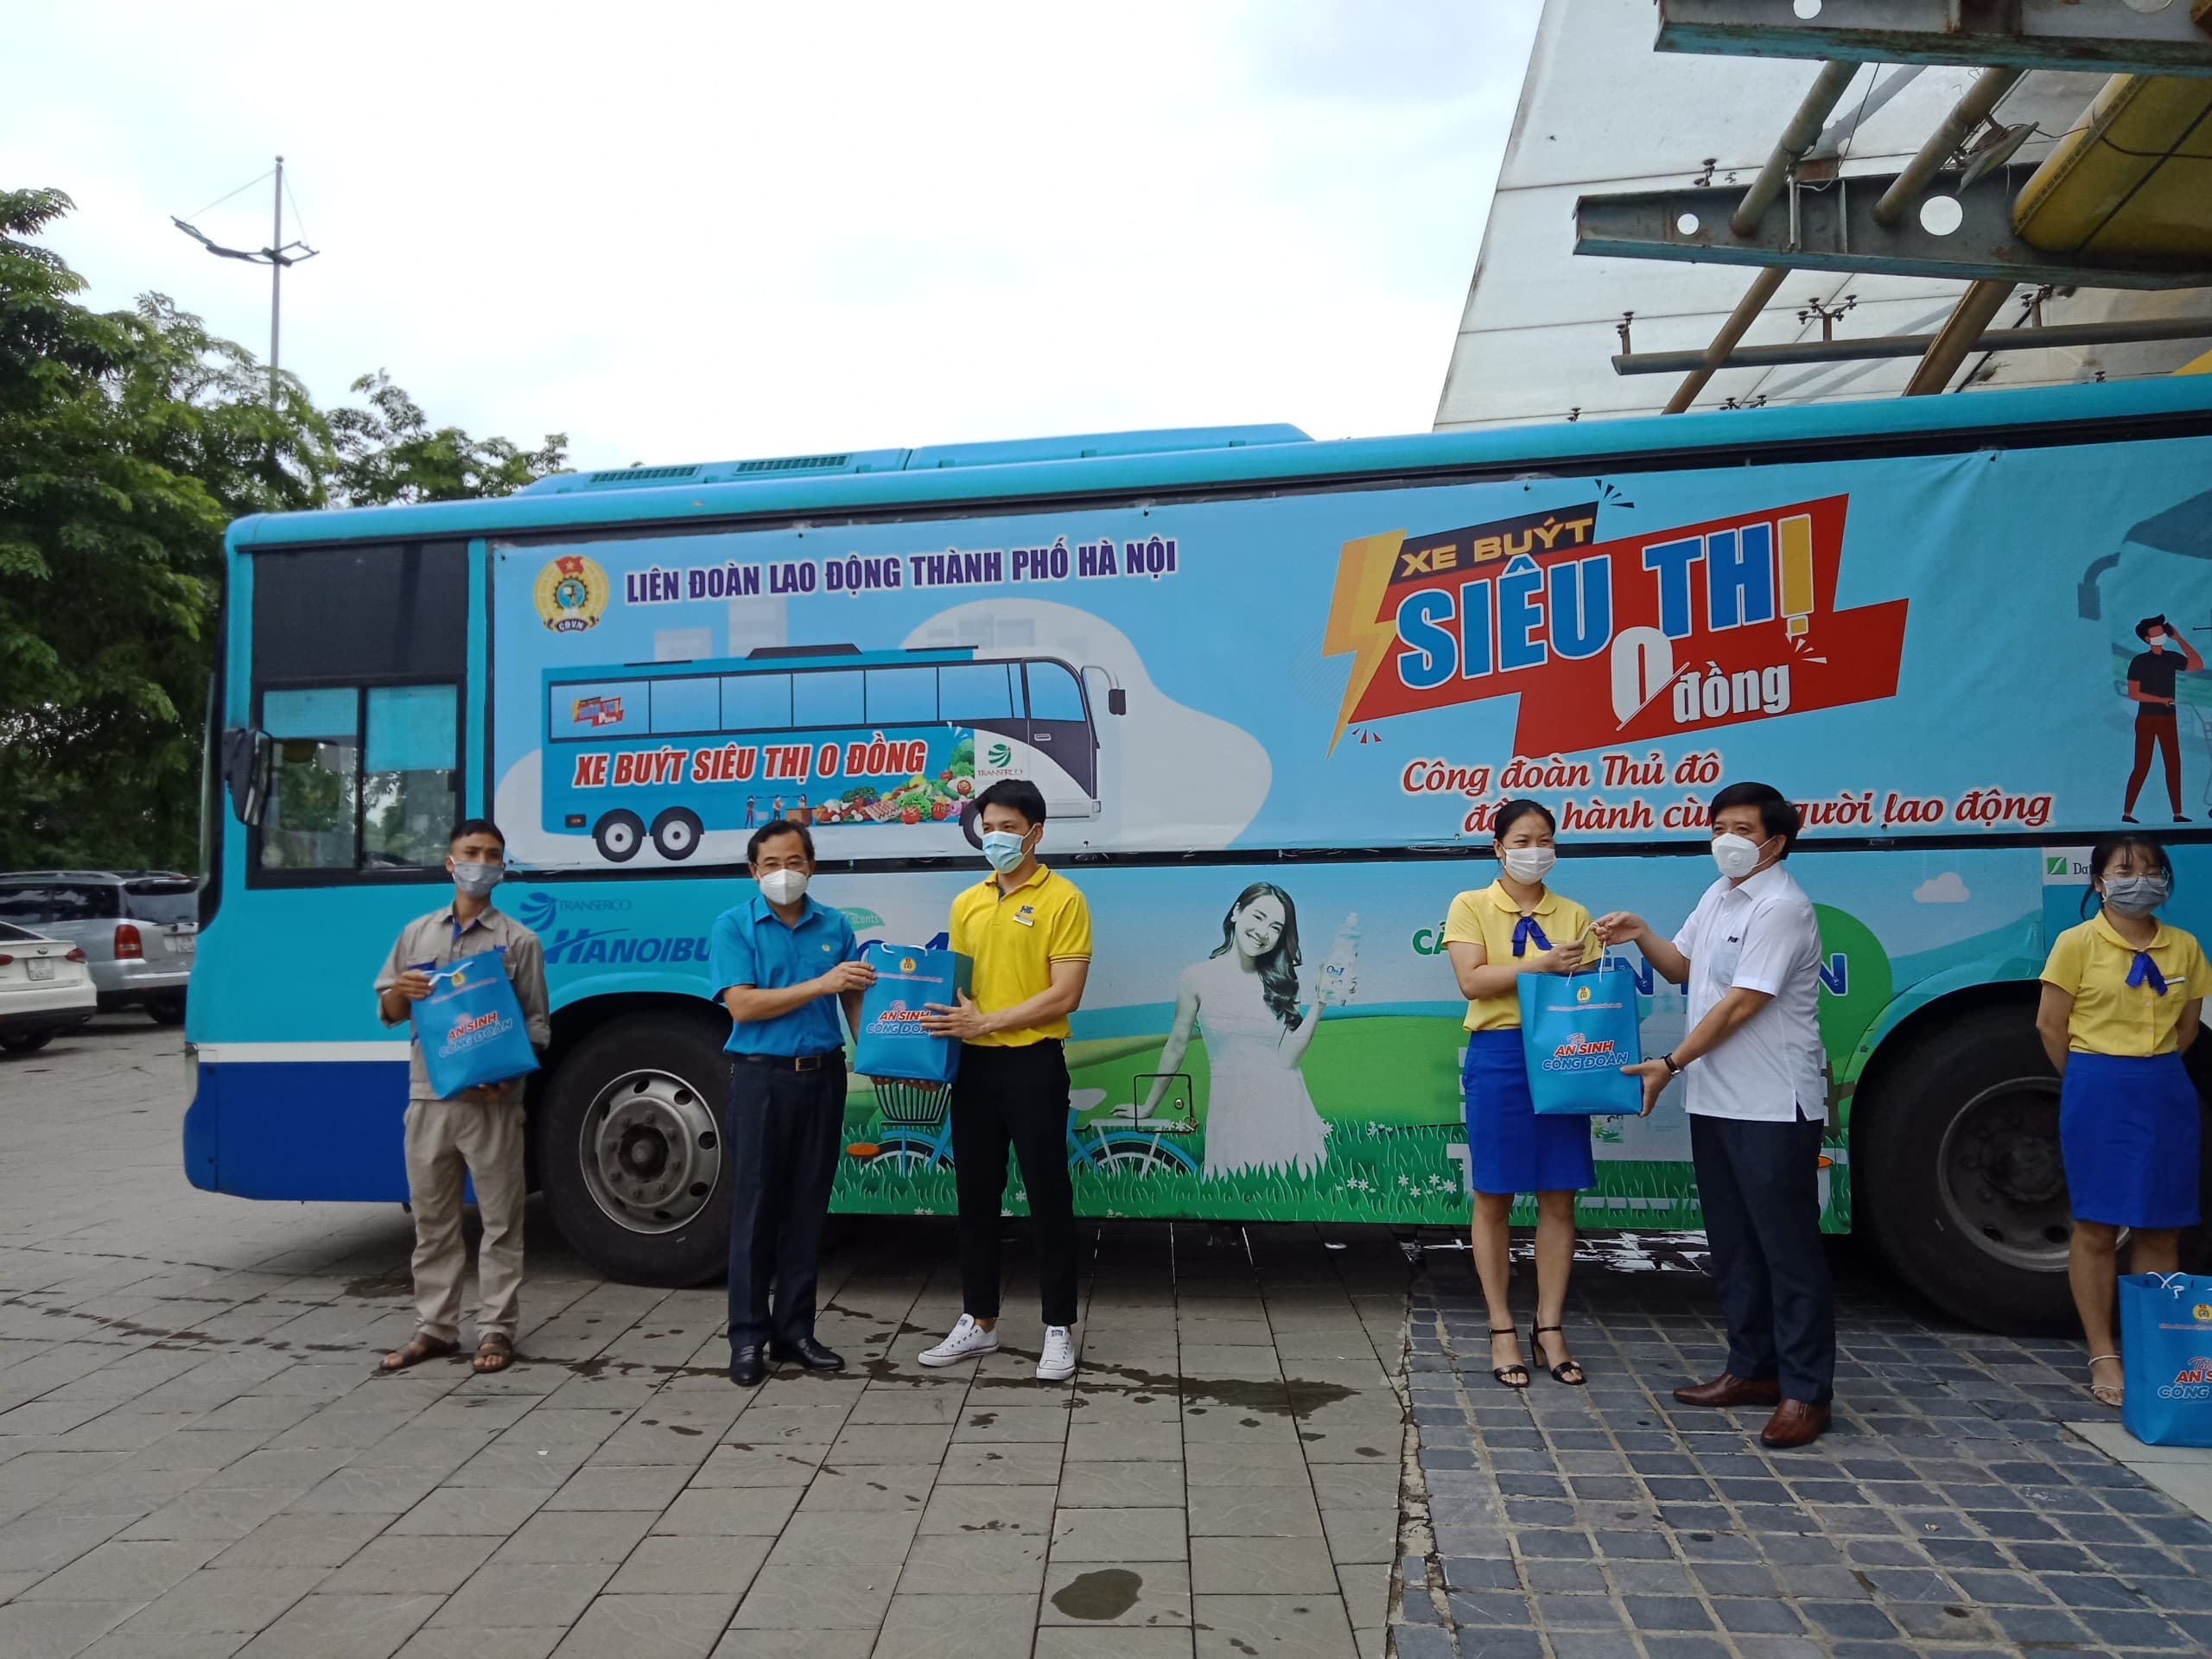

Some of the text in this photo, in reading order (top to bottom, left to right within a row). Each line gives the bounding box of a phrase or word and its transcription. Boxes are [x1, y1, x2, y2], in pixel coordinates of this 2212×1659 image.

[626, 535, 1176, 603] LIÊN ĐOÀN LAO ĐỘNG THÀNH PHỐ HÀ NỘI
[1401, 518, 1594, 577] XE BUÝT
[1395, 555, 1612, 690] SIÊU
[1672, 659, 1791, 725] đồng
[574, 754, 608, 785] XE
[613, 747, 687, 784] BUÝT
[692, 743, 756, 781] SIÊU
[765, 746, 811, 783] THỊ
[845, 733, 926, 775] ĐỒNG
[1402, 752, 1720, 797] Công đoàn Thủ đô
[1561, 797, 1654, 830] hành
[1662, 797, 1712, 828] cù
[1884, 793, 1944, 823] lao
[1955, 788, 2052, 827] động
[543, 927, 712, 964] HANOIBU
[448, 1011, 498, 1040] AN SINH
[879, 1011, 897, 1021] AN
[1554, 1040, 1614, 1057] AN SINH
[2174, 1370, 2202, 1383] AN
